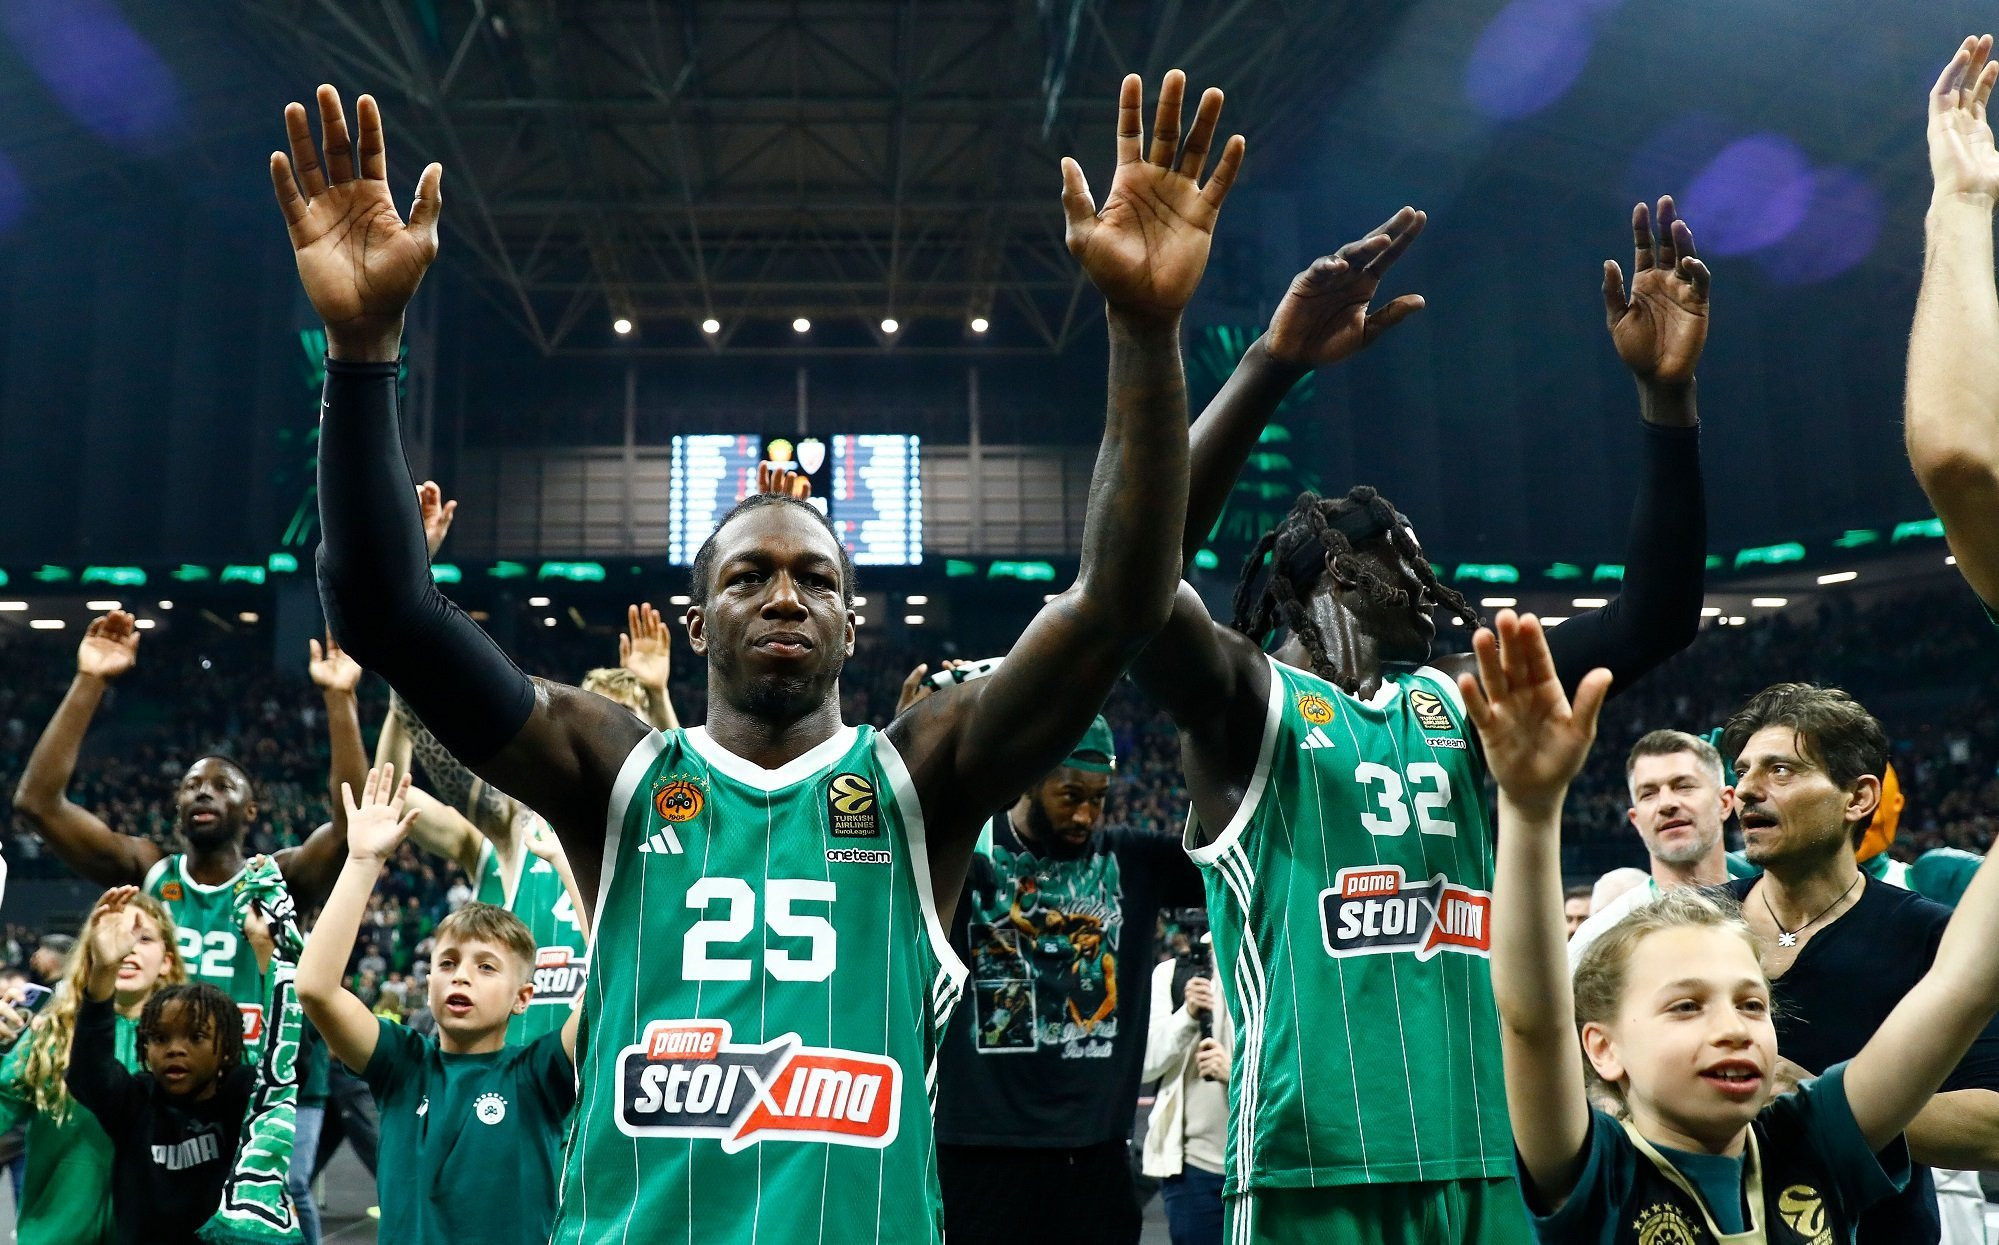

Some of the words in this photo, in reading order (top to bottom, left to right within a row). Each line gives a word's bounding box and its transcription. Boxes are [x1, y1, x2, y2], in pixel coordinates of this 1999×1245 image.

[1354, 761, 1457, 838] 32
[834, 814, 874, 822] TURKISH
[835, 821, 875, 829] AIRLINES
[826, 848, 891, 862] oneteam
[1346, 874, 1396, 896] pame
[681, 876, 837, 982] 25
[176, 926, 238, 978] 22
[651, 1027, 715, 1055] pame
[151, 1133, 219, 1170] PUMA
